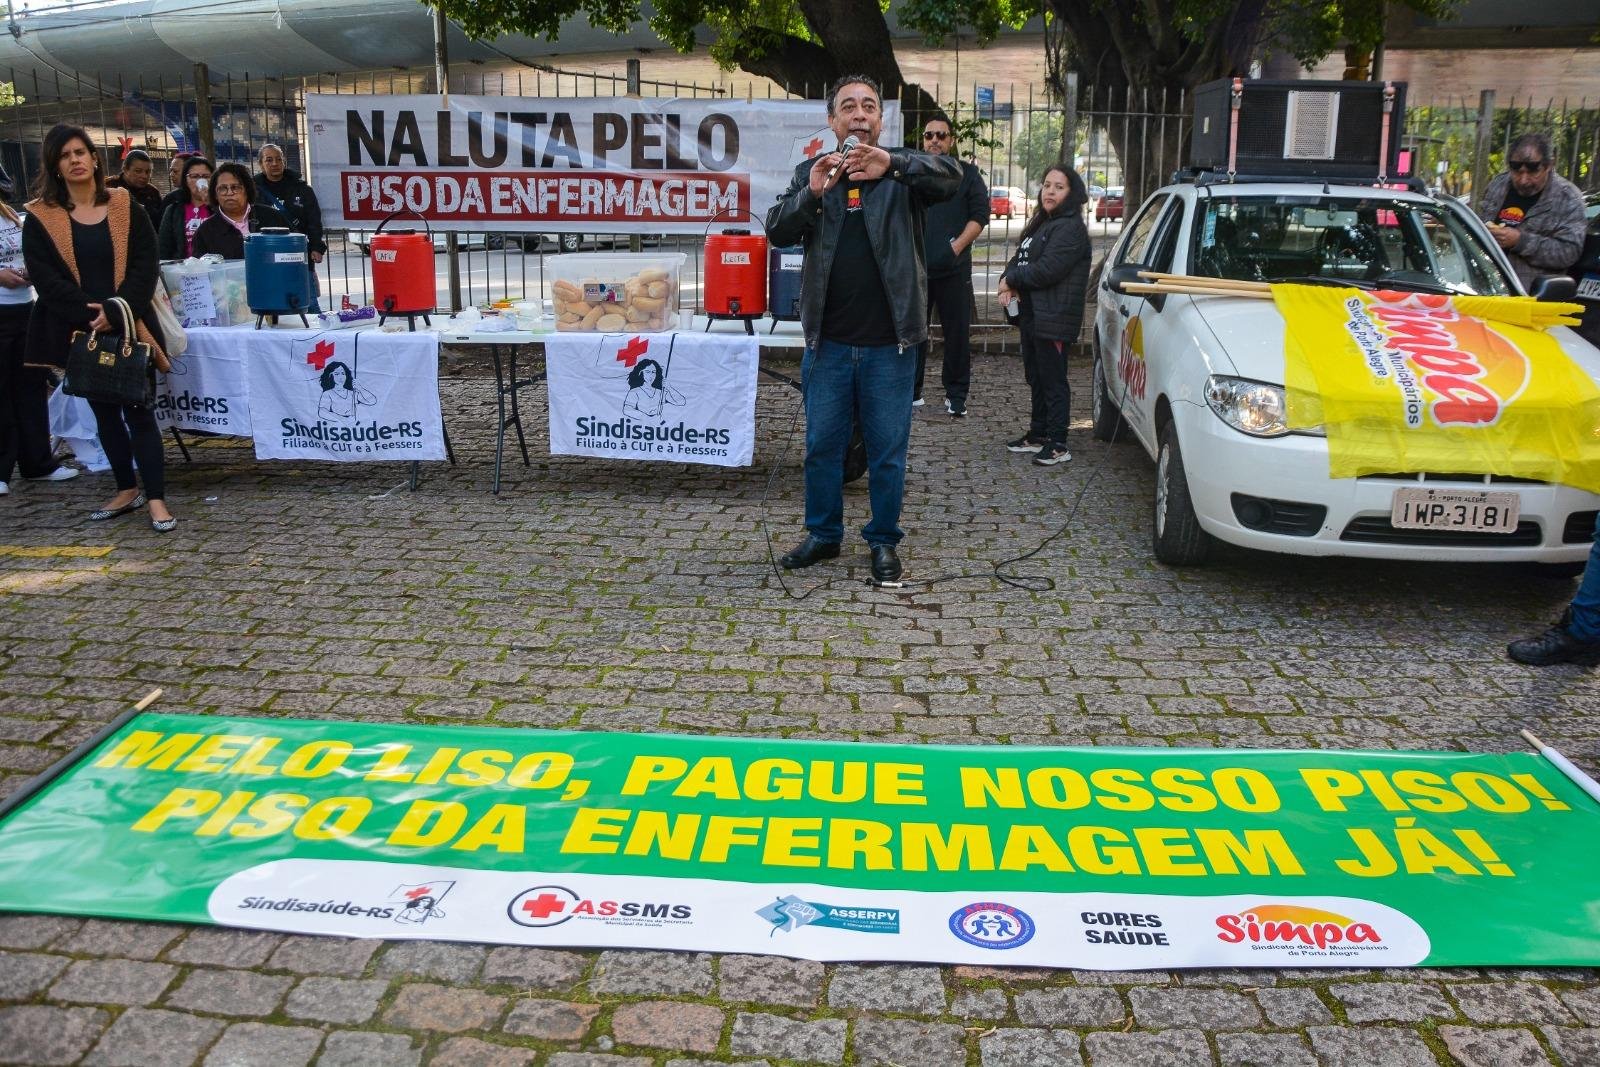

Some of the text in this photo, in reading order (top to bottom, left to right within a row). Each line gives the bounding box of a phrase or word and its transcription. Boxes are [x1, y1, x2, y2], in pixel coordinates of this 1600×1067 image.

[346, 110, 740, 171] NA LUTA PELO
[347, 174, 739, 218] PISO DA ENFERMAGEM
[281, 417, 423, 441] Sindisaúde-RS
[575, 415, 730, 445] Sindisaúde-RS
[282, 439, 321, 449] Filiado
[331, 442, 352, 452] CUT
[365, 443, 373, 453] à
[375, 441, 423, 450] Feessers
[576, 438, 728, 457] Filiado à CUT e à Feessers
[95, 729, 1572, 814] MELO LISO, PAGUE NOSSO PISO!
[131, 787, 1516, 878] PISO DA ENFERMAGEM JÁ!
[238, 895, 395, 920] Sindisaúde-RS
[571, 899, 692, 919] ASSMS
[829, 908, 897, 921] ASSERPV
[1080, 911, 1163, 928] CORES
[1085, 927, 1170, 946] SAÚDE
[1215, 914, 1382, 949] Simpa
[1251, 943, 1296, 951] Sindicato
[1328, 943, 1389, 952] Municipários
[1329, 950, 1360, 958] Alegre
